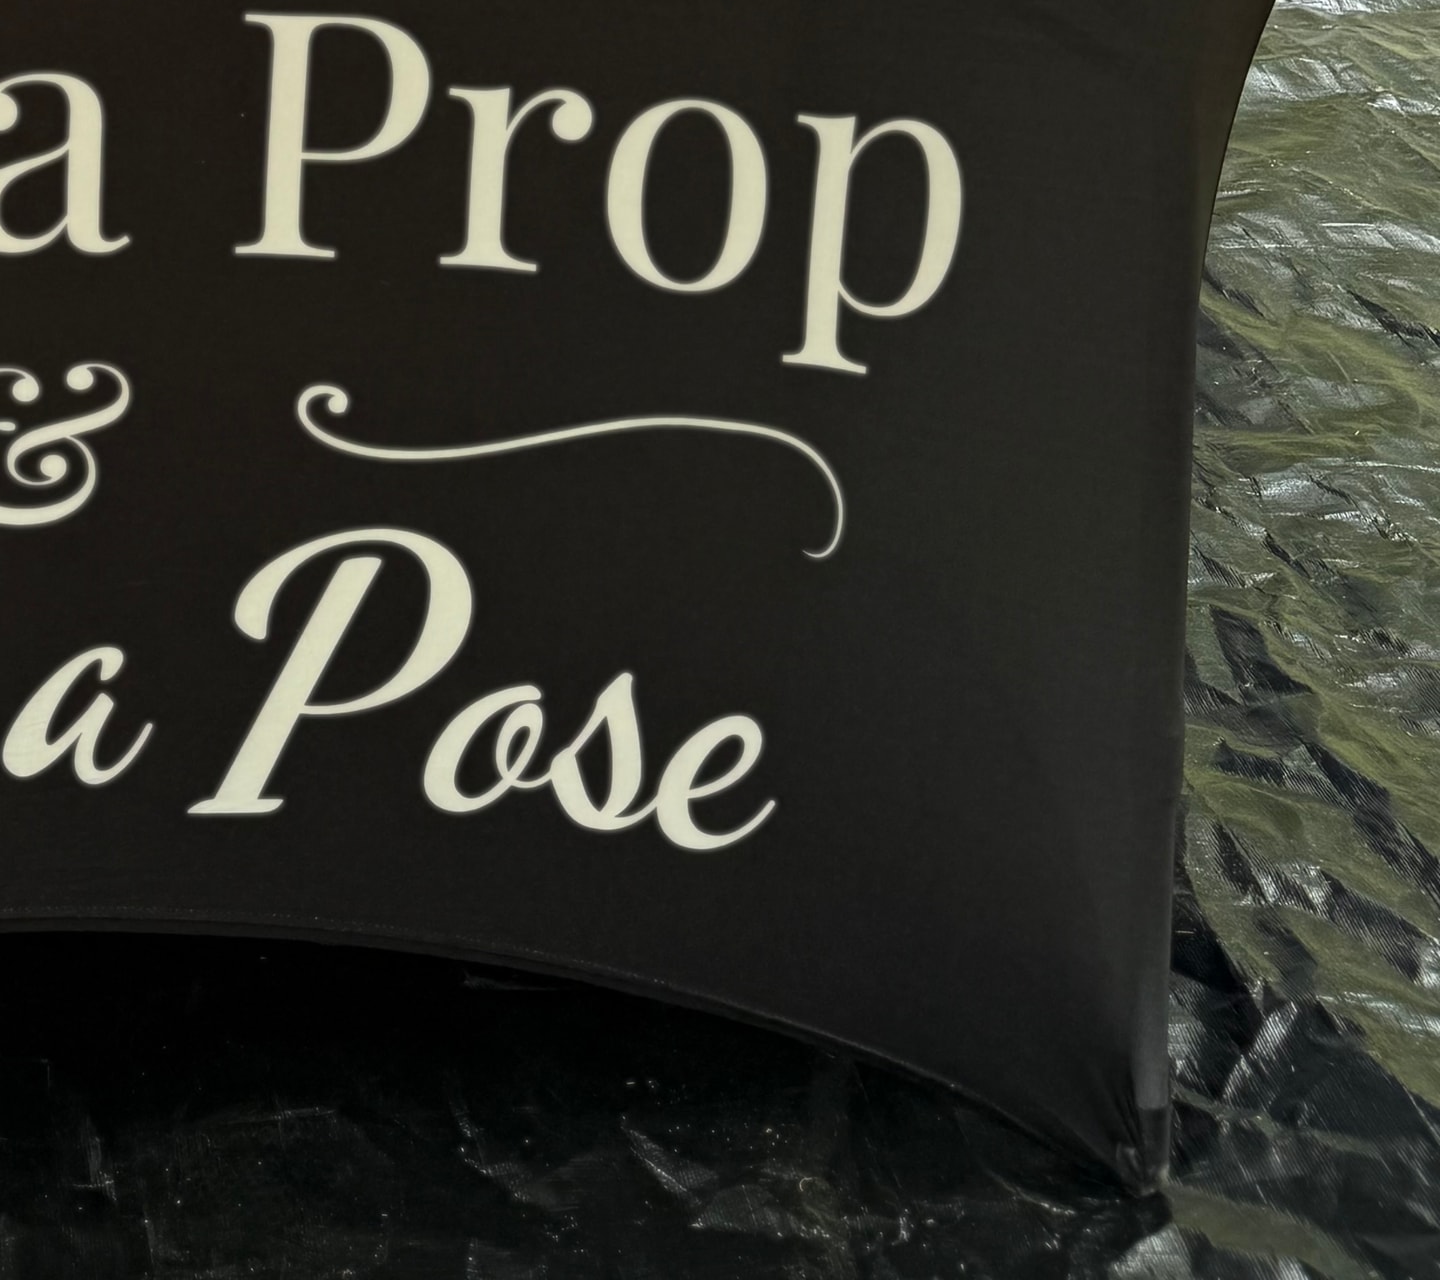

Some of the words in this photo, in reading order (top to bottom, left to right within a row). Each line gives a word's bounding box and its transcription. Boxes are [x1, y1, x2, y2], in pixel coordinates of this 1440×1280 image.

[233, 11, 964, 375] Prop
[1, 646, 154, 787] a
[187, 527, 776, 851] Pose
